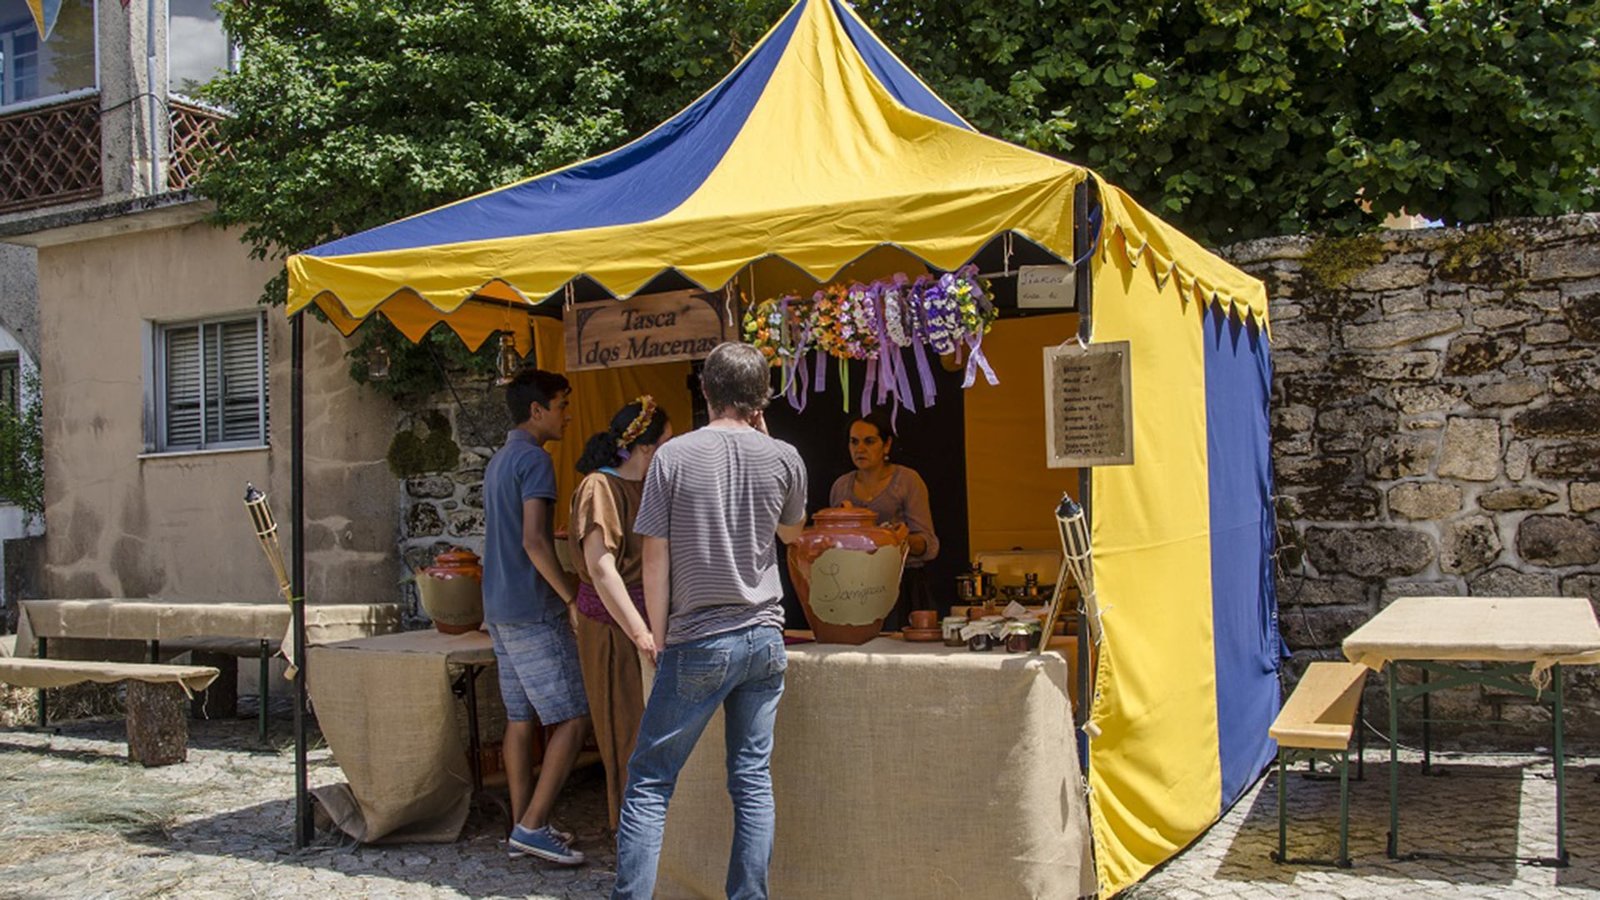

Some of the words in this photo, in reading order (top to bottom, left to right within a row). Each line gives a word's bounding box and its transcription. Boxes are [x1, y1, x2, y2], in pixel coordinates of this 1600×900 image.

[621, 308, 677, 332] Tasca
[585, 340, 620, 364] dos
[625, 336, 718, 361] Macenas
